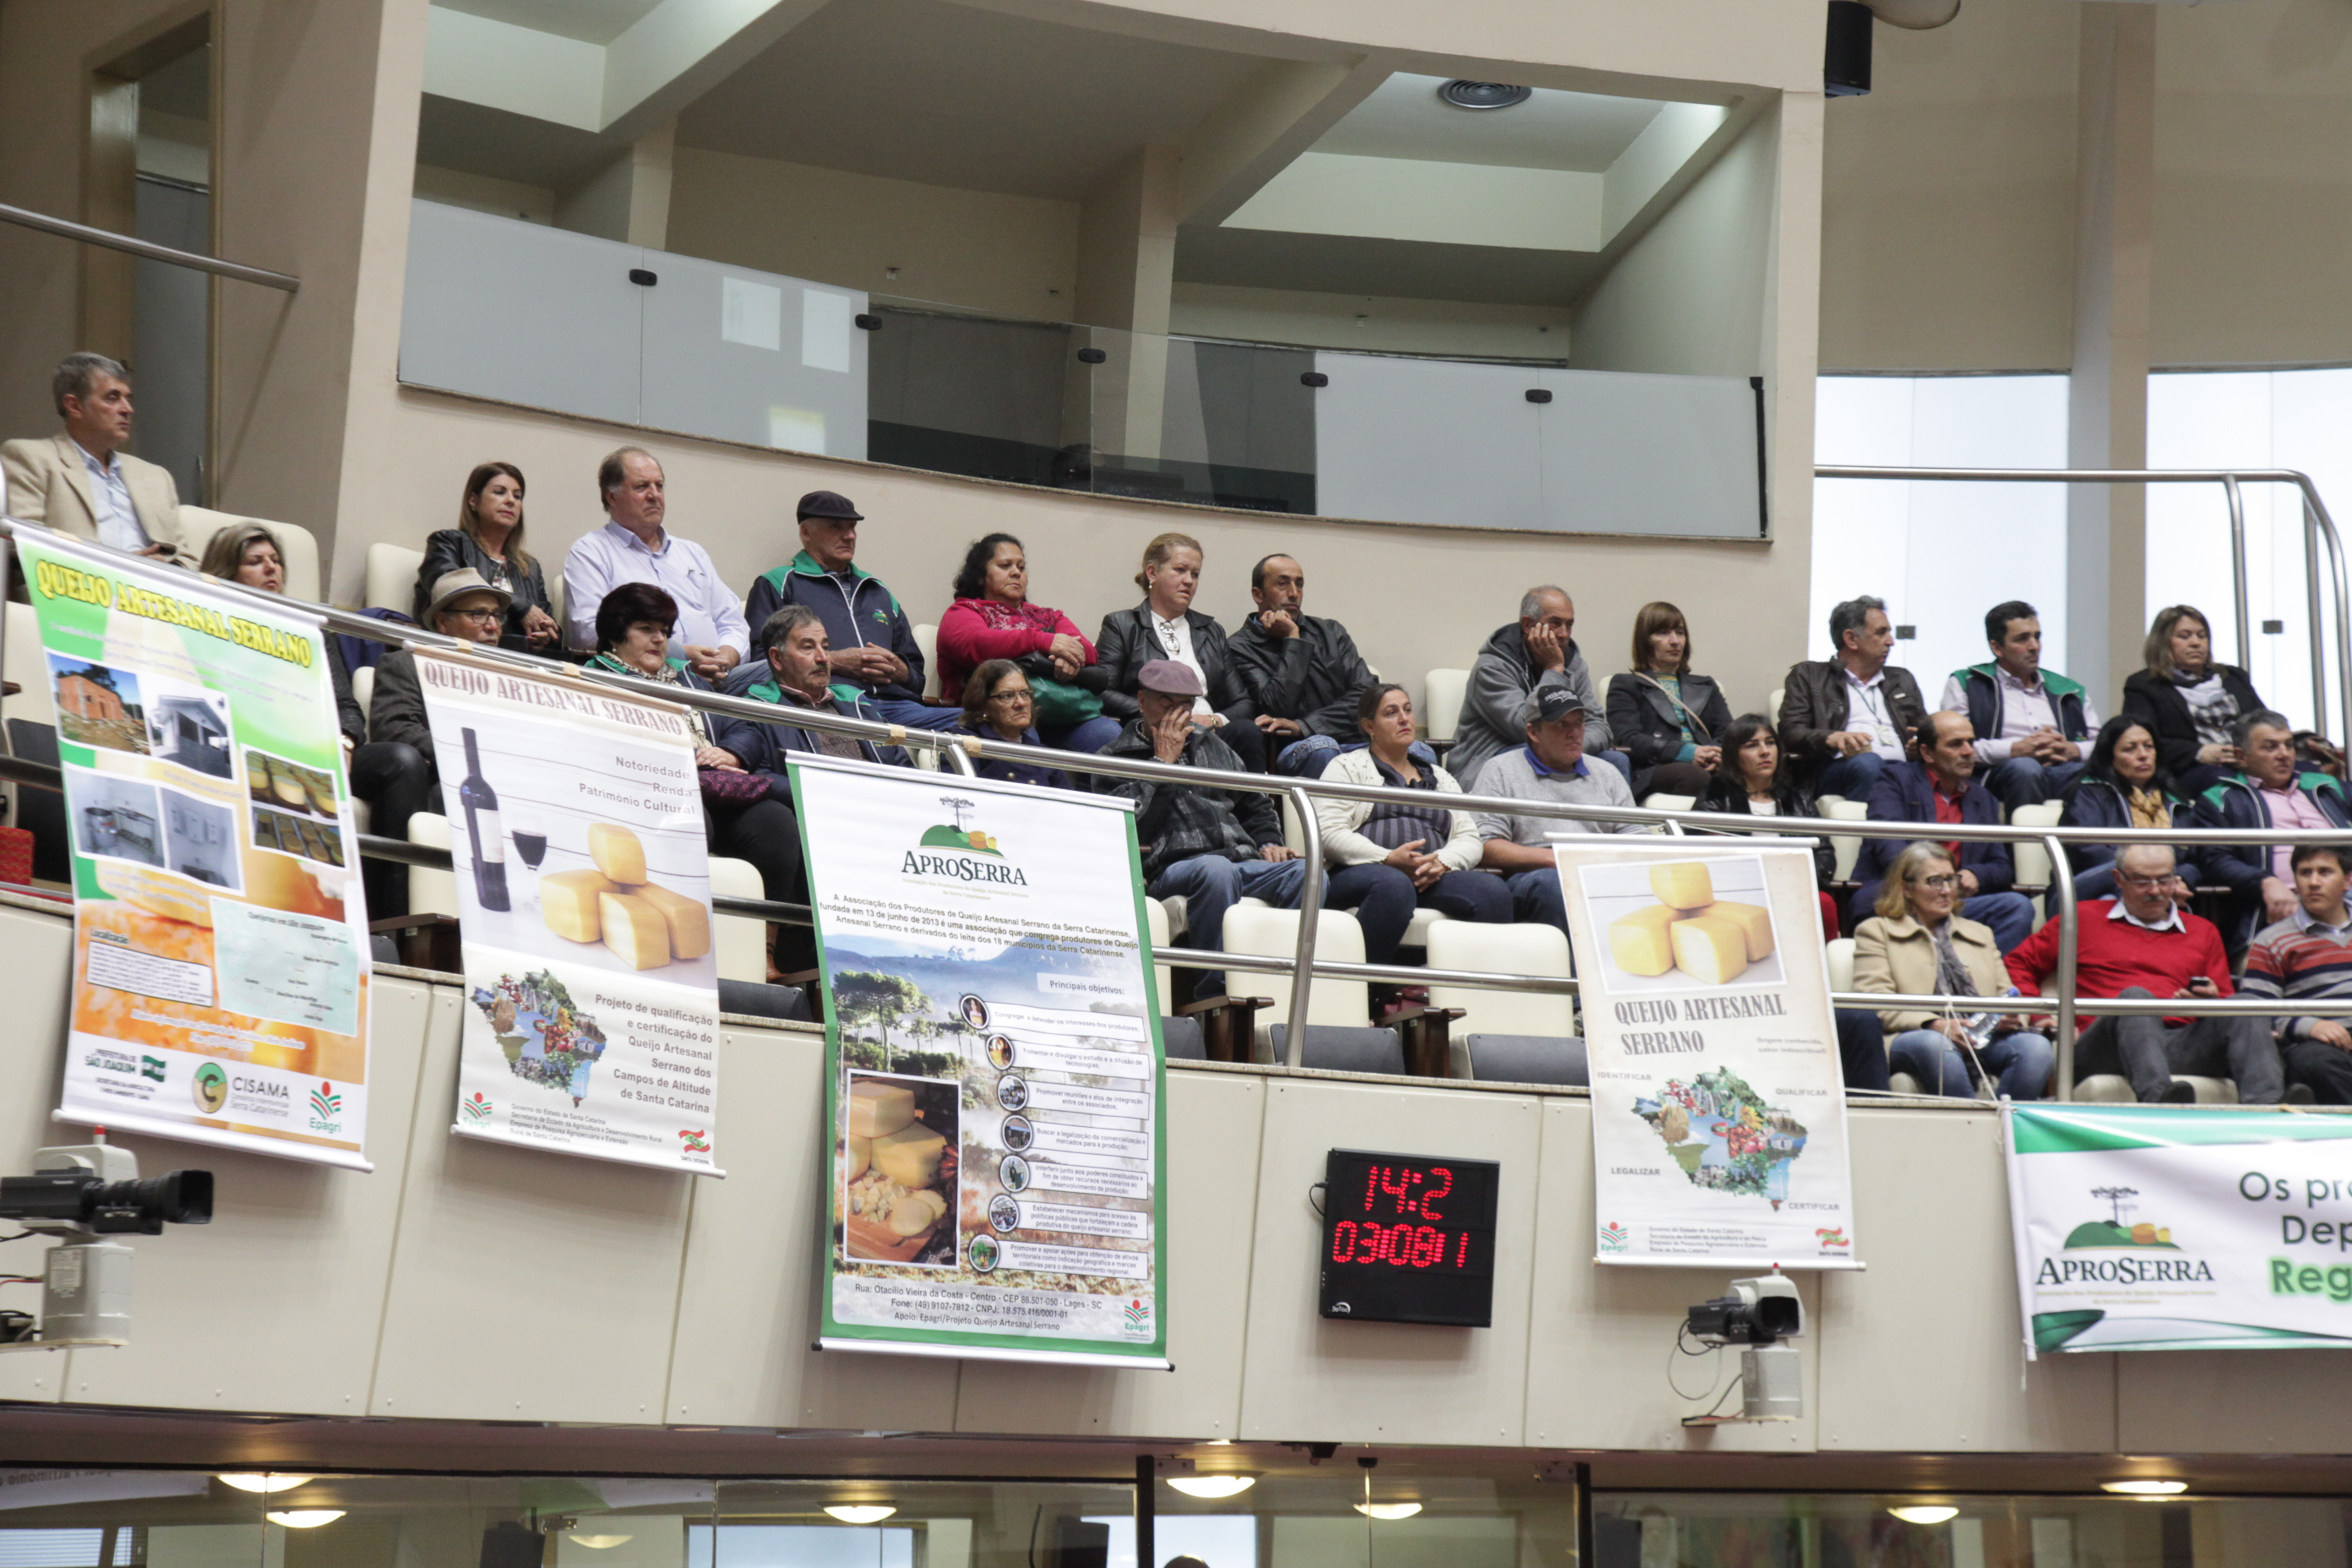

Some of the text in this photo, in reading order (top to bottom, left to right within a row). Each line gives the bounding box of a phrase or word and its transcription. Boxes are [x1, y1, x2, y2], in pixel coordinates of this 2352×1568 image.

[36, 560, 112, 608] QUEIJO
[115, 582, 230, 641] ARTESANAL
[228, 616, 311, 667] SERRANO
[424, 661, 683, 736] QUEIJO ARTESANAL SERRANO
[616, 756, 690, 781] Notoriedade
[580, 783, 695, 814] Patrimônio Cultural
[652, 782, 693, 798] Renda
[819, 902, 851, 913] fundada
[888, 912, 908, 922] junho
[922, 917, 939, 926] 2013
[965, 924, 1006, 935] associação
[1010, 929, 1022, 938] que
[1025, 931, 1059, 942] congrega
[1062, 935, 1102, 945] produtores
[1115, 939, 1138, 950] Queijo
[844, 896, 886, 908] Associação
[904, 904, 945, 916] Produtores
[958, 911, 983, 922] Queijo
[984, 915, 1019, 925] Artesanal
[1021, 919, 1049, 929] Serrano
[1064, 924, 1083, 933] Serra
[1086, 926, 1130, 938] Catarinense,
[836, 916, 870, 927] Artesanal
[873, 920, 901, 932] Serrano
[911, 927, 946, 938] derivados
[949, 931, 958, 939] do
[961, 933, 975, 941] leite
[1004, 939, 1044, 950] municípios
[1048, 943, 1056, 951] da
[1058, 945, 1078, 953] Serra
[1080, 947, 1125, 958] Catarinense.
[1050, 980, 1124, 995] Principais objetivos:
[596, 994, 713, 1026] Projeto de qualificação
[1614, 994, 1787, 1026] QUEIJO ARTESANAL
[637, 1021, 697, 1040] certificação
[700, 1033, 712, 1043] do
[1620, 1031, 1704, 1055] SERRANO
[629, 1036, 711, 1060] Queijo Artesanal
[651, 1059, 711, 1078] Serrano dos
[1597, 1071, 1652, 1081] IDENTIFICAR
[232, 1077, 289, 1099] CISAMA
[614, 1069, 710, 1096] Campos de Altitude
[621, 1089, 710, 1113] de Santa Catarina
[1037, 1088, 1063, 1097] Promover
[1114, 1097, 1143, 1105] integração
[1086, 1102, 1118, 1110] associados;
[511, 1103, 533, 1113] Governo
[544, 1109, 561, 1118] Estado
[585, 1116, 606, 1124] Catarina
[309, 1118, 341, 1134] Epagri
[509, 1120, 533, 1130] Empresa
[542, 1125, 565, 1135] Pesquisa
[511, 1112, 537, 1122] Secretaria
[547, 1118, 564, 1126] Estado
[573, 1123, 600, 1133] Agricultura
[606, 1128, 648, 1141] Desenvolvimento
[649, 1134, 662, 1142] Rural
[1611, 1168, 1660, 1176] LEGALIZAR
[2240, 1172, 2352, 1209] Os pr
[1601, 1244, 1629, 1253] Epagri
[2271, 1260, 2352, 1301] Reg
[855, 1284, 872, 1293] Rua:
[874, 1285, 903, 1295] Otacílio
[906, 1288, 927, 1297] Vieira
[941, 1290, 963, 1298] Costa
[971, 1292, 996, 1301] Centro
[1003, 1293, 1019, 1303] CEP
[1021, 1296, 1058, 1306] 88.501-050
[1064, 1300, 1085, 1309] Lages
[891, 1298, 912, 1308] Fone:
[915, 1300, 929, 1309] (49)
[932, 1302, 969, 1311] 9107-7812
[976, 1304, 999, 1314] CNPJ:
[895, 1312, 1059, 1331] Apoio: Epagri/Projeto Queijo Artesanal Serrano
[1125, 1323, 1149, 1331] Epagri
